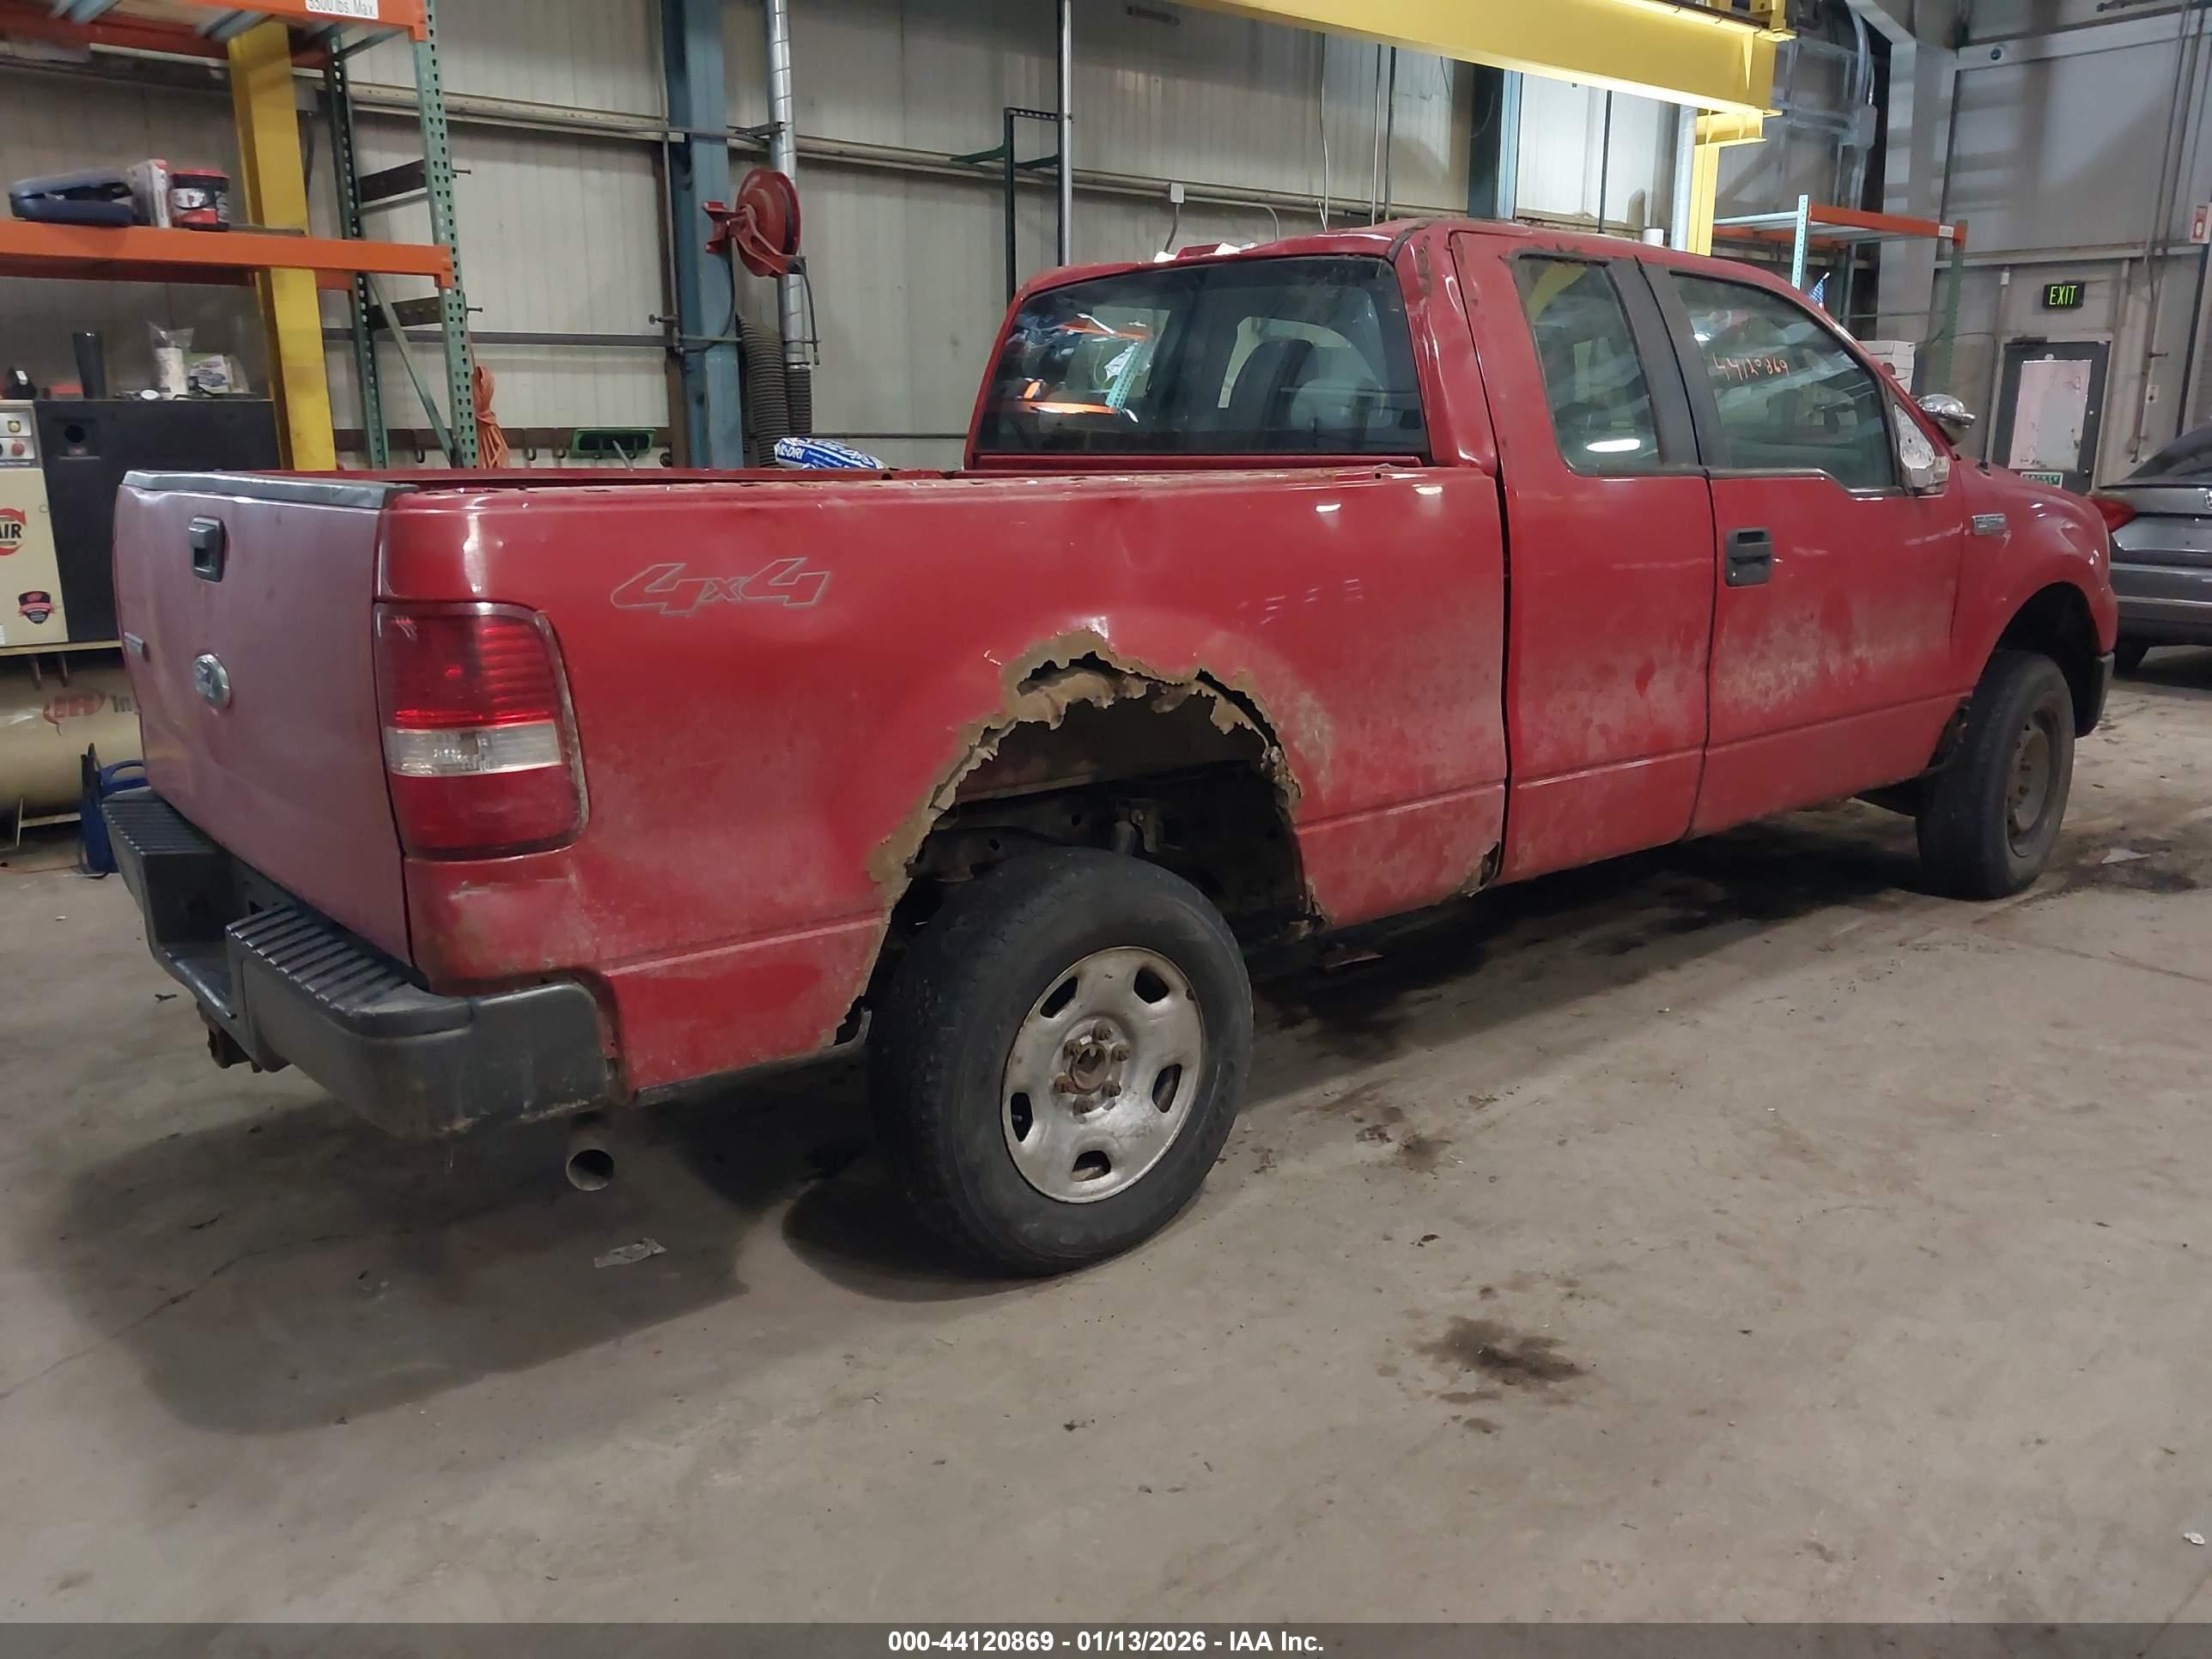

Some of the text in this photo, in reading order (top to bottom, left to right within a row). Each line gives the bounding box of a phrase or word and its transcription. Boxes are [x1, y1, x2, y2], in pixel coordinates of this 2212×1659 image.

[2049, 285, 2077, 306] EXIT
[0, 523, 22, 539] IR
[611, 556, 831, 617] 4x4
